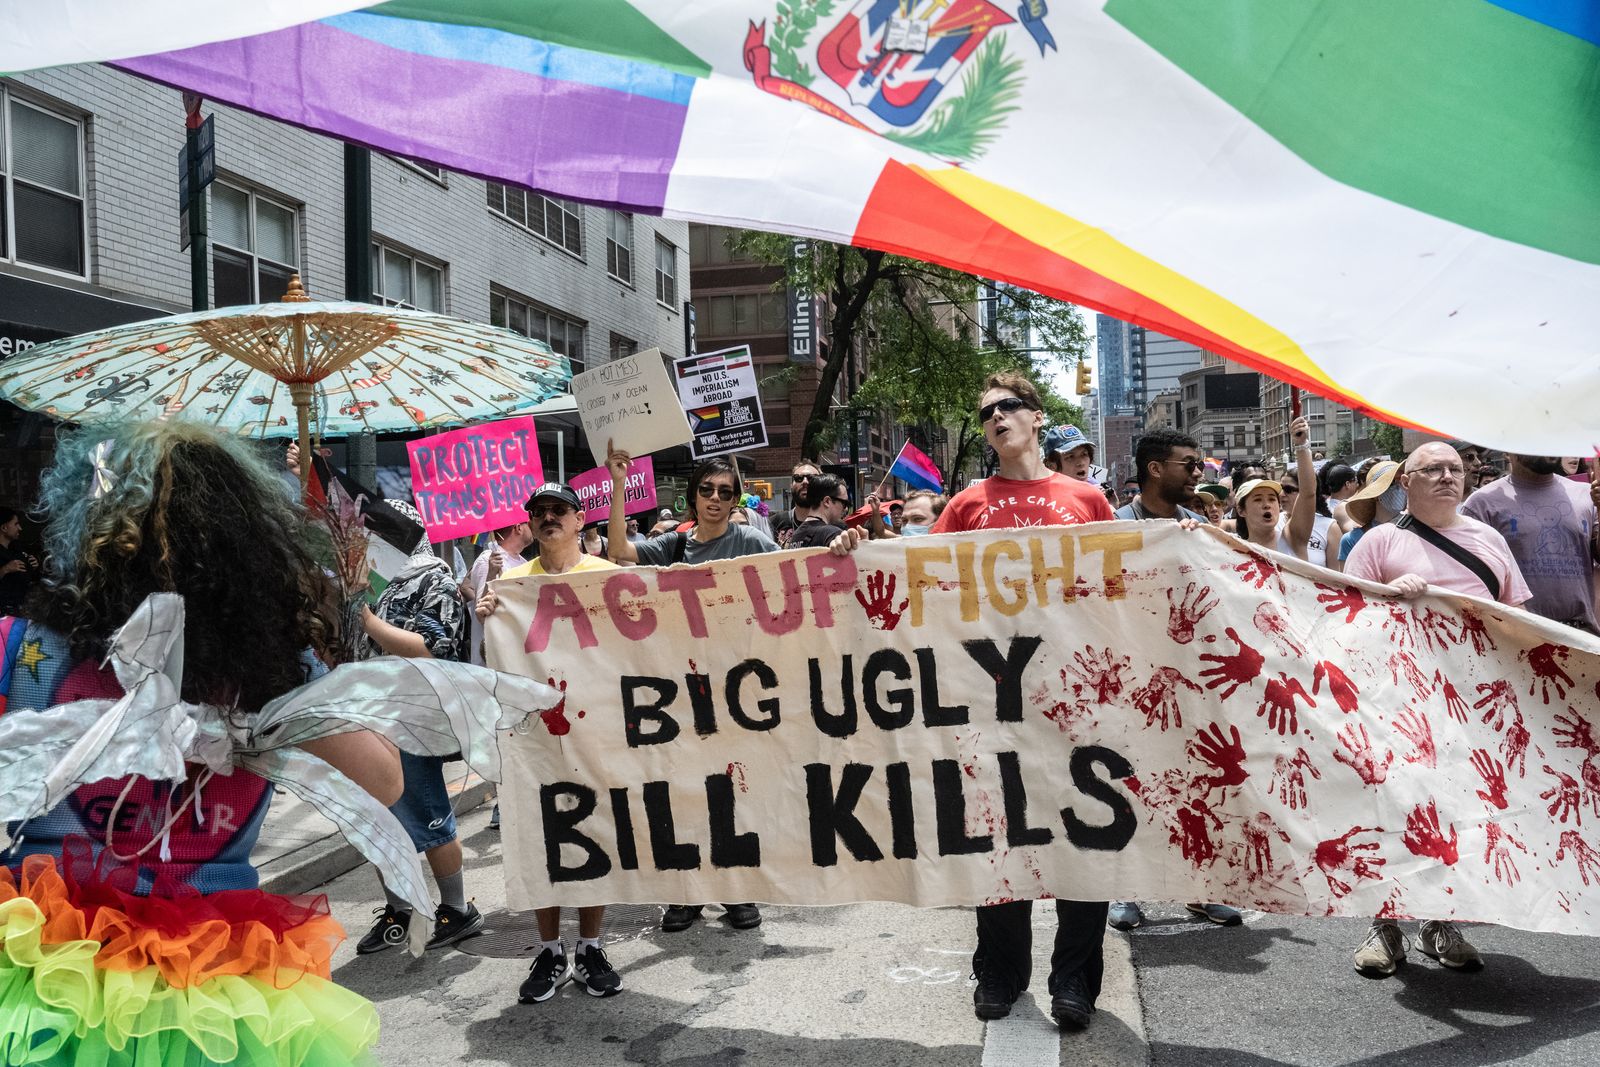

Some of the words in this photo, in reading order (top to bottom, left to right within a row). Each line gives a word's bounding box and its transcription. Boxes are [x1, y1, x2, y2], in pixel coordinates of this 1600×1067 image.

[591, 372, 598, 384] A
[600, 364, 613, 381] HOT
[615, 358, 639, 378] MESS
[702, 373, 713, 384] NO
[714, 370, 730, 381] U.S.
[626, 384, 649, 399] OCEAN
[692, 378, 740, 396] IMPERIALISM
[703, 390, 733, 404] ABROAD
[731, 400, 740, 408] NO
[594, 411, 615, 431] SUPPORT
[723, 406, 750, 418] FASCISM
[723, 417, 732, 426] AT
[702, 437, 755, 452] @workersworld_party
[720, 430, 753, 442] workers.org
[413, 429, 530, 487] PROTECT
[575, 472, 646, 500] NON-BIARY
[416, 483, 489, 527] TRANS
[589, 486, 648, 511] BEAIFUL
[524, 566, 717, 654] ACT
[741, 552, 858, 636] UP
[905, 531, 1144, 628] FIGHT
[620, 657, 781, 748] BIG
[808, 633, 1044, 739] UGLY
[540, 773, 761, 886] BILL
[803, 745, 1138, 867] KILLS
